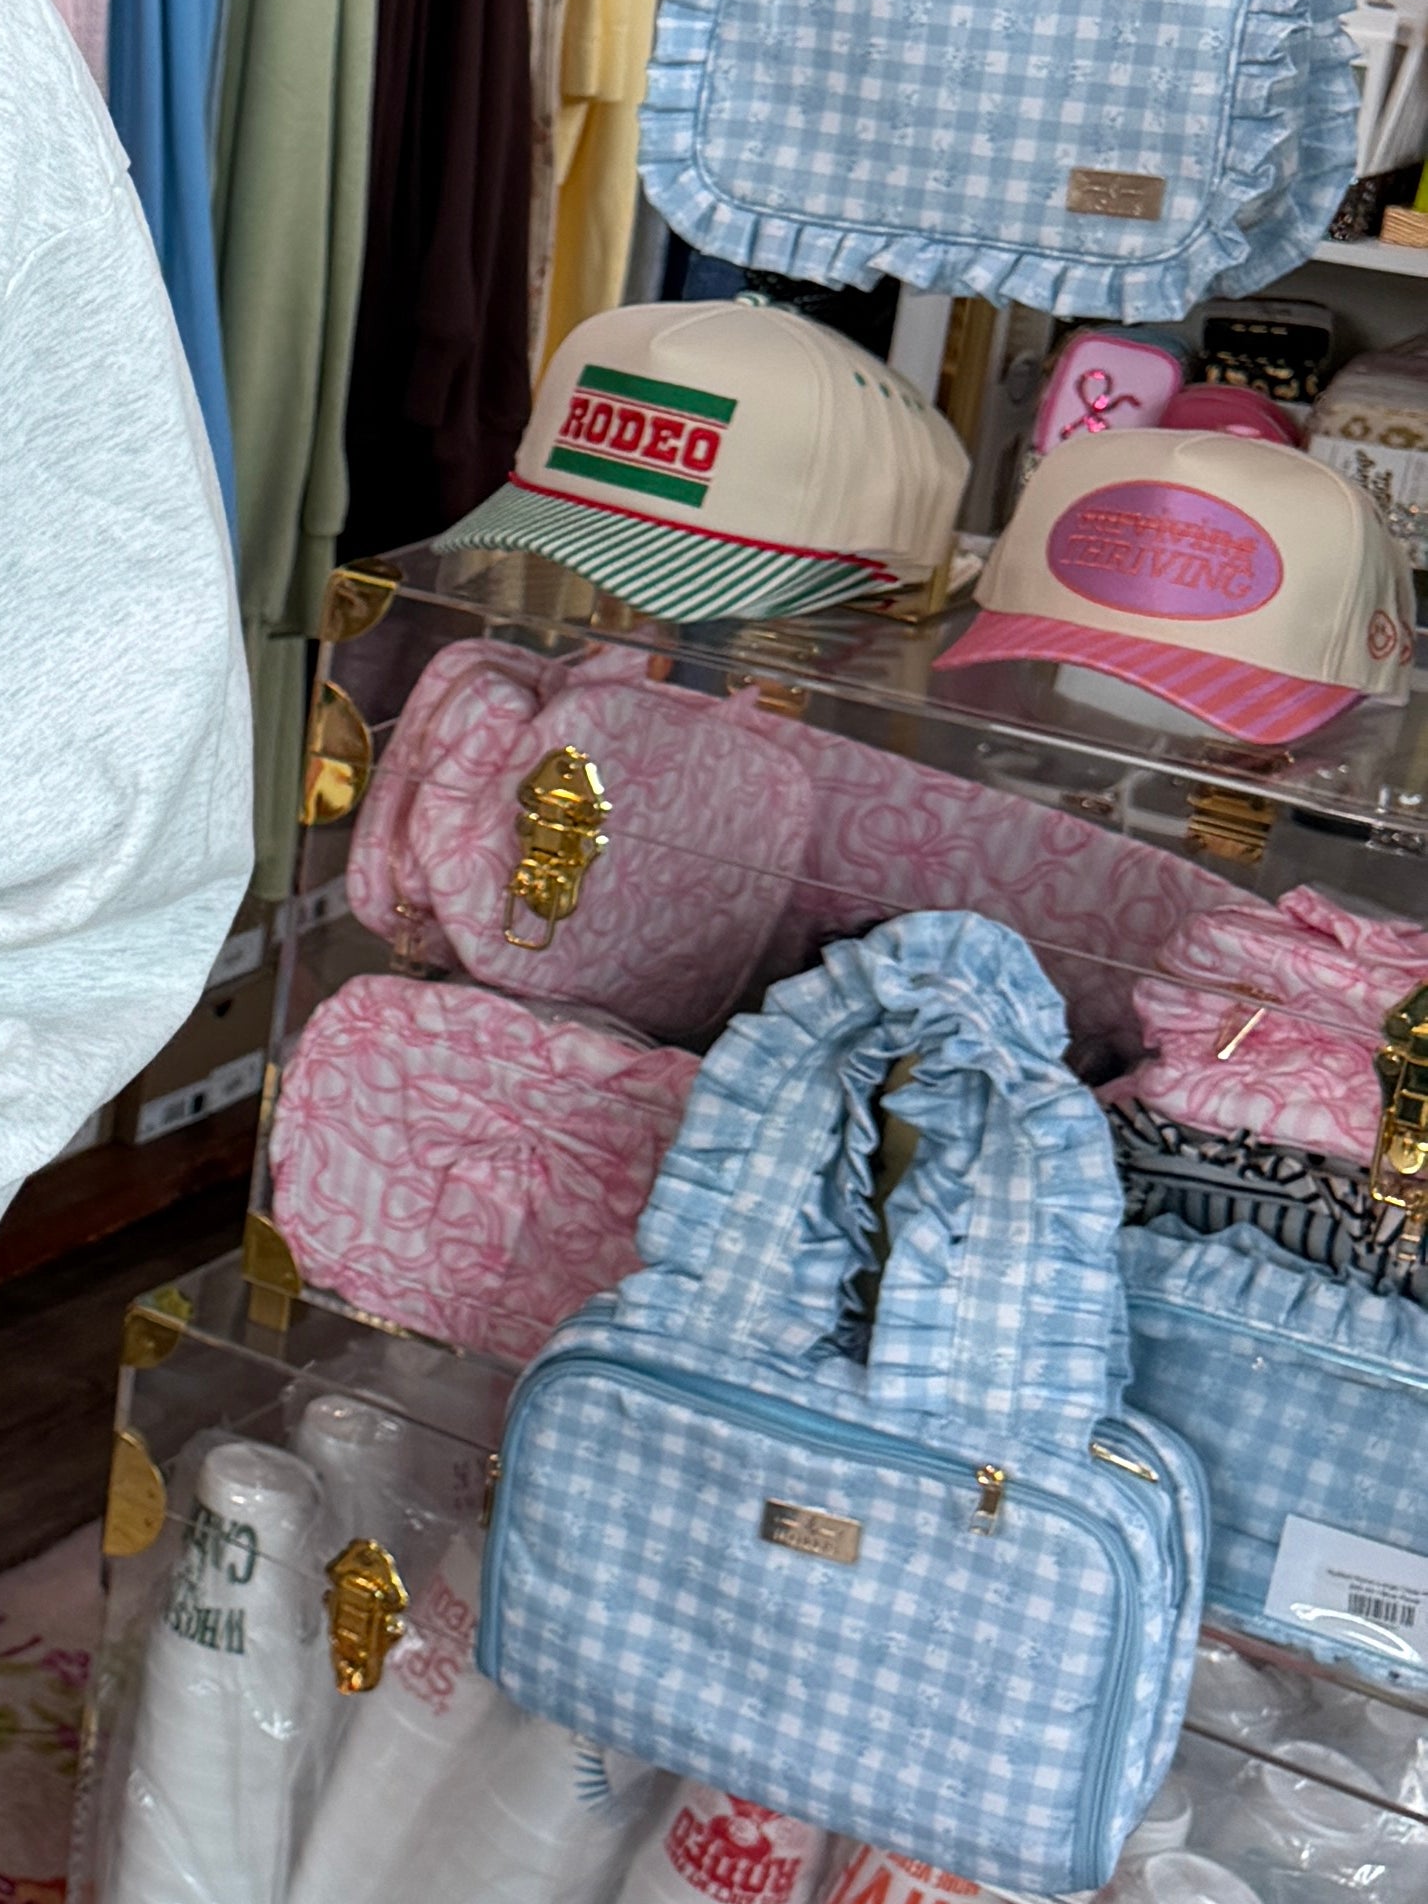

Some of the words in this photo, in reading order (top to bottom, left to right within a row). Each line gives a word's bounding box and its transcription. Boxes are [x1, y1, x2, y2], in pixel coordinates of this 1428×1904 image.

[558, 395, 721, 473] RODEO
[1059, 533, 1253, 601] THRIVING
[669, 1806, 802, 1894] RODEO
